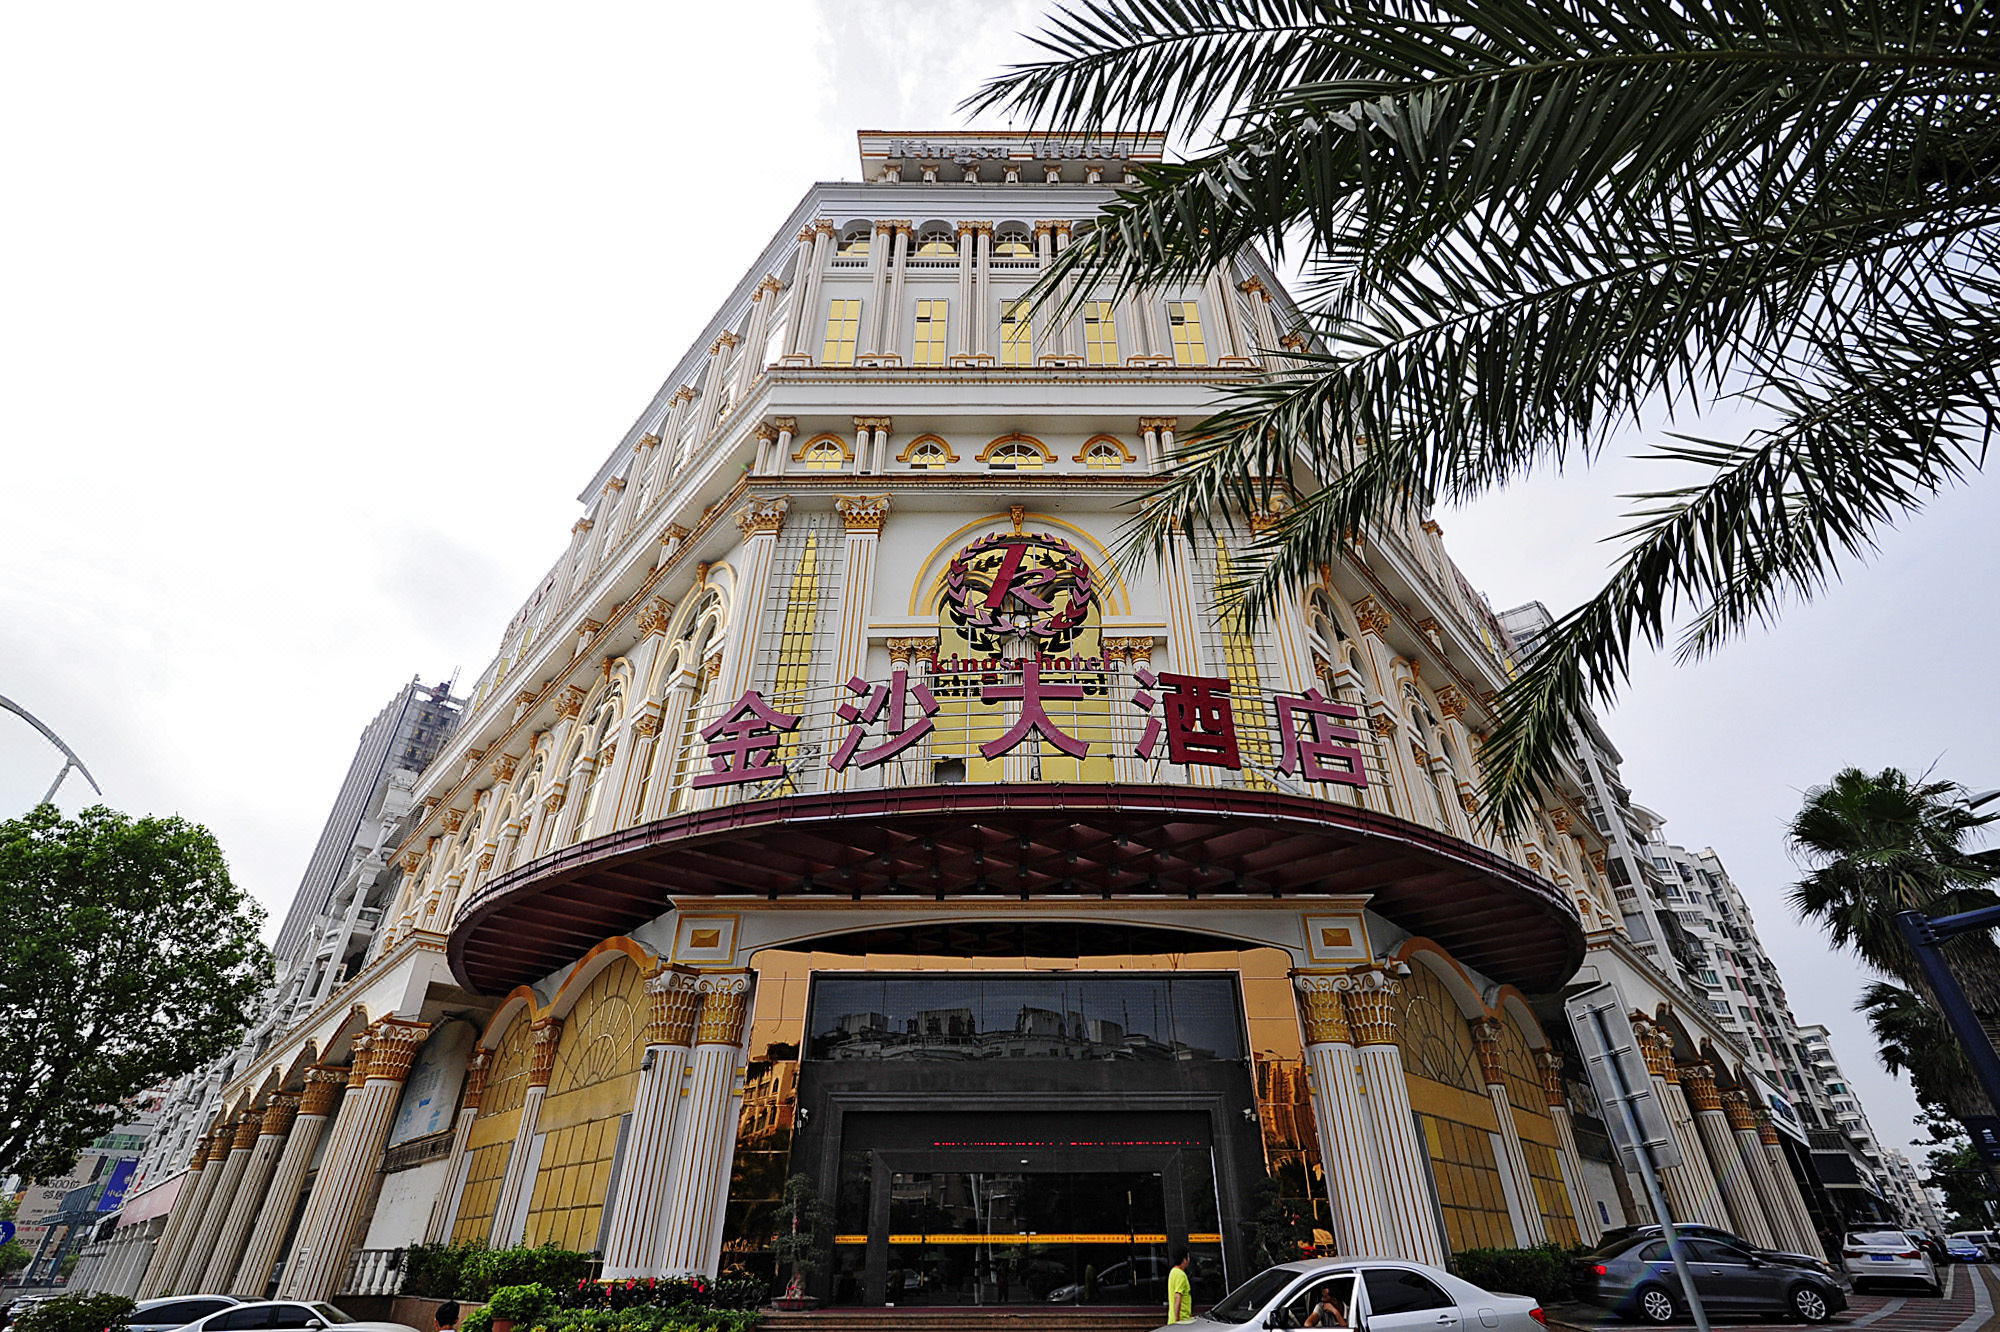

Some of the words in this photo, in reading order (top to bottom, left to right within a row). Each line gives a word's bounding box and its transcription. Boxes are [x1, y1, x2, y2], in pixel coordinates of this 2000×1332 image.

[888, 139, 1010, 165] Kingsa
[1033, 141, 1128, 159] Hotel
[691, 662, 1369, 790] 金沙大酒店
